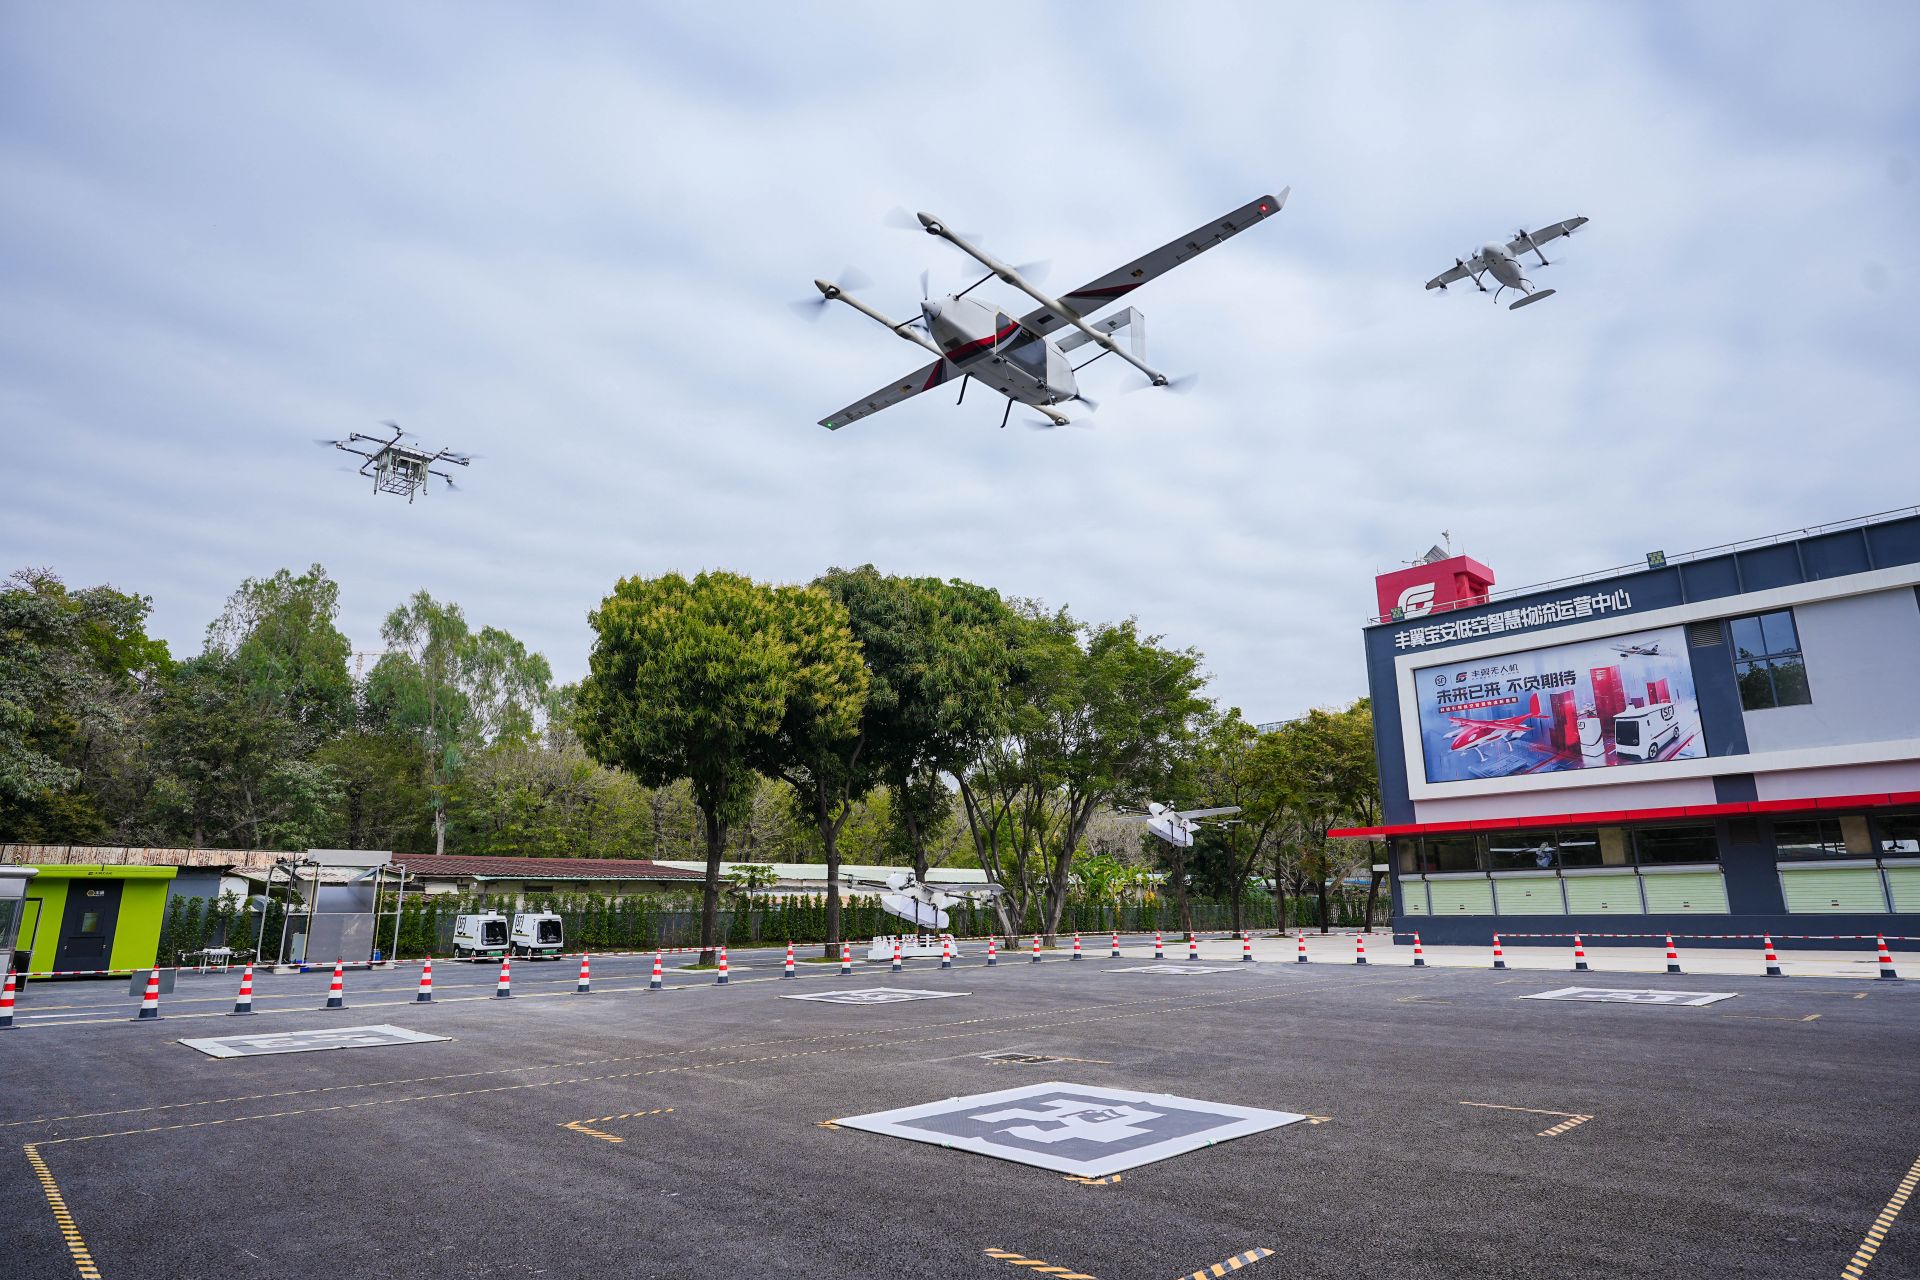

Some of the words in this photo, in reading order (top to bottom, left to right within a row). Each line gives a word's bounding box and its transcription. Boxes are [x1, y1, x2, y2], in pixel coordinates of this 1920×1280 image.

[1394, 588, 1632, 650] 丰翼宝安低空智慧物流运营中心
[1436, 681, 1501, 704] 未来已来
[1506, 670, 1577, 693] 不负期待
[1471, 663, 1519, 678] 丰翼无人机
